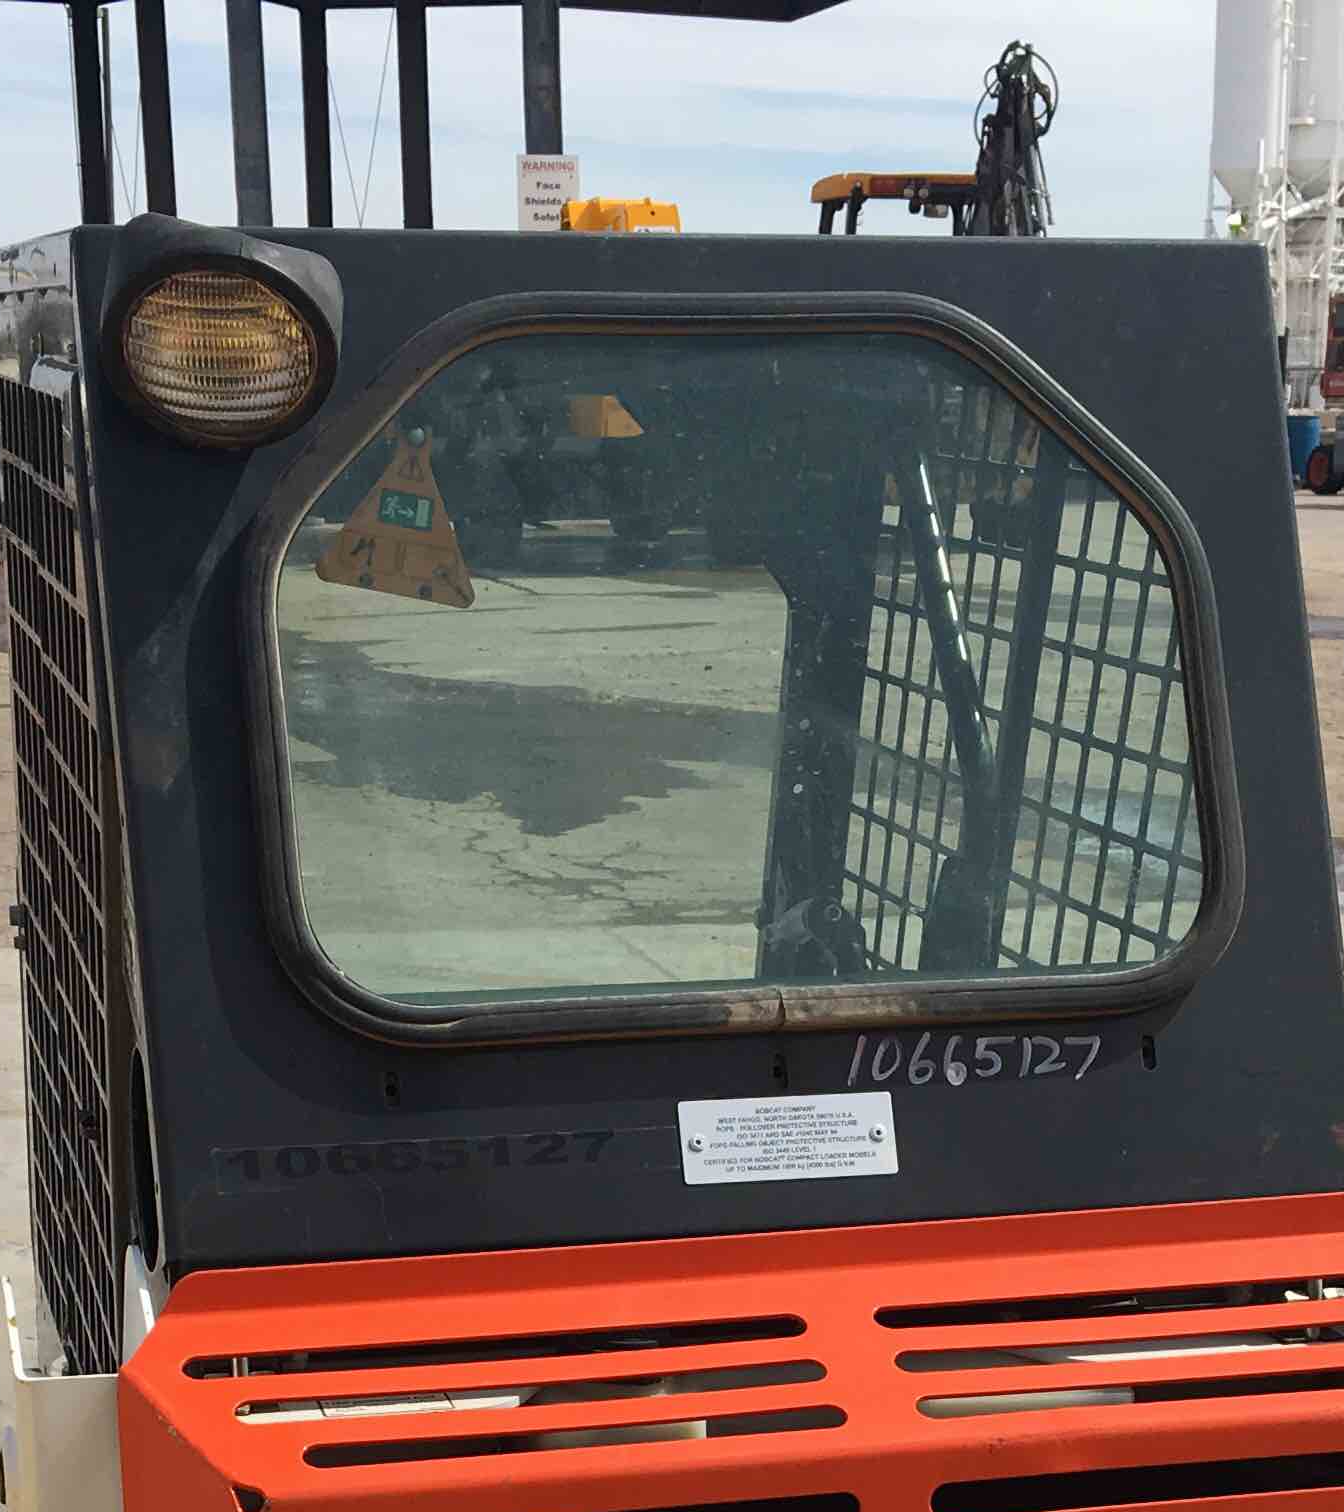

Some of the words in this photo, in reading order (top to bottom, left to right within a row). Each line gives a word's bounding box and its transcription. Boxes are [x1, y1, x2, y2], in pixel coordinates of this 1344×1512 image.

[522, 161, 575, 171] WARNING
[536, 182, 560, 190] Face
[525, 197, 561, 206] Shields
[848, 1032, 1101, 1086] 10665127
